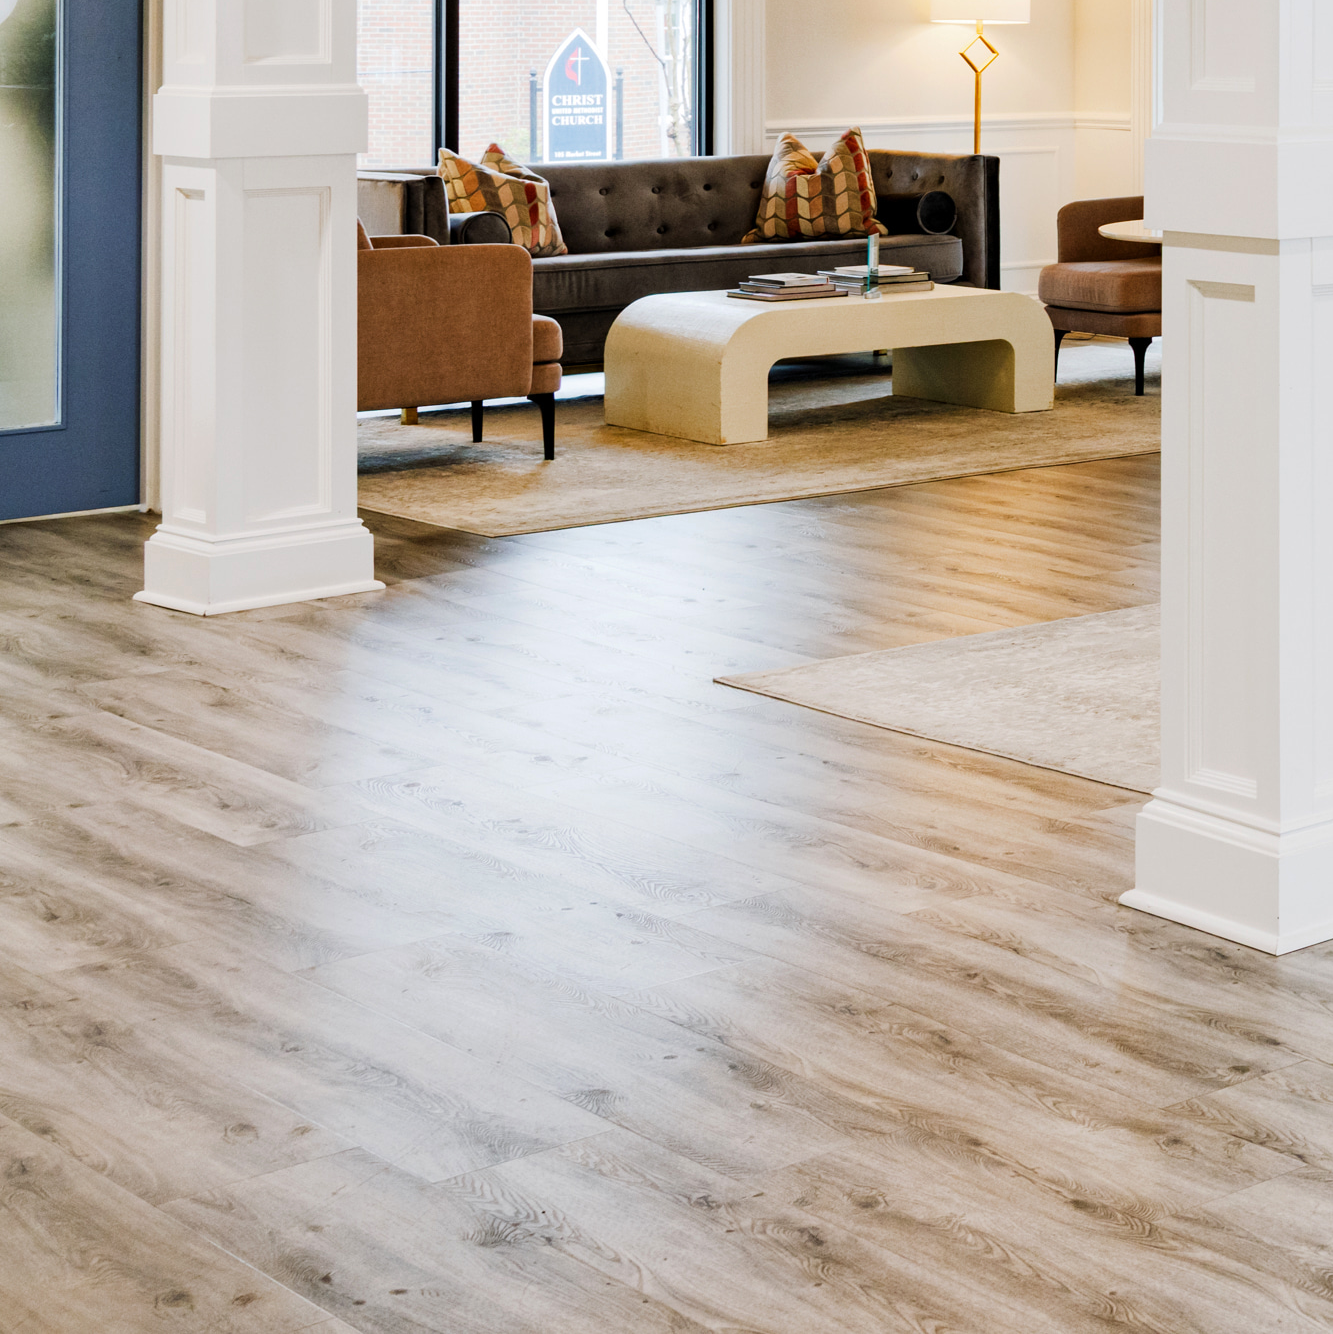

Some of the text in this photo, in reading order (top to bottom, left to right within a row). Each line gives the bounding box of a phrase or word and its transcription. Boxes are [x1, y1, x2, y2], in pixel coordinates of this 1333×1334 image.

[551, 94, 604, 106] CHRIST
[551, 107, 572, 115] UNITED
[551, 115, 603, 126] CHURCH
